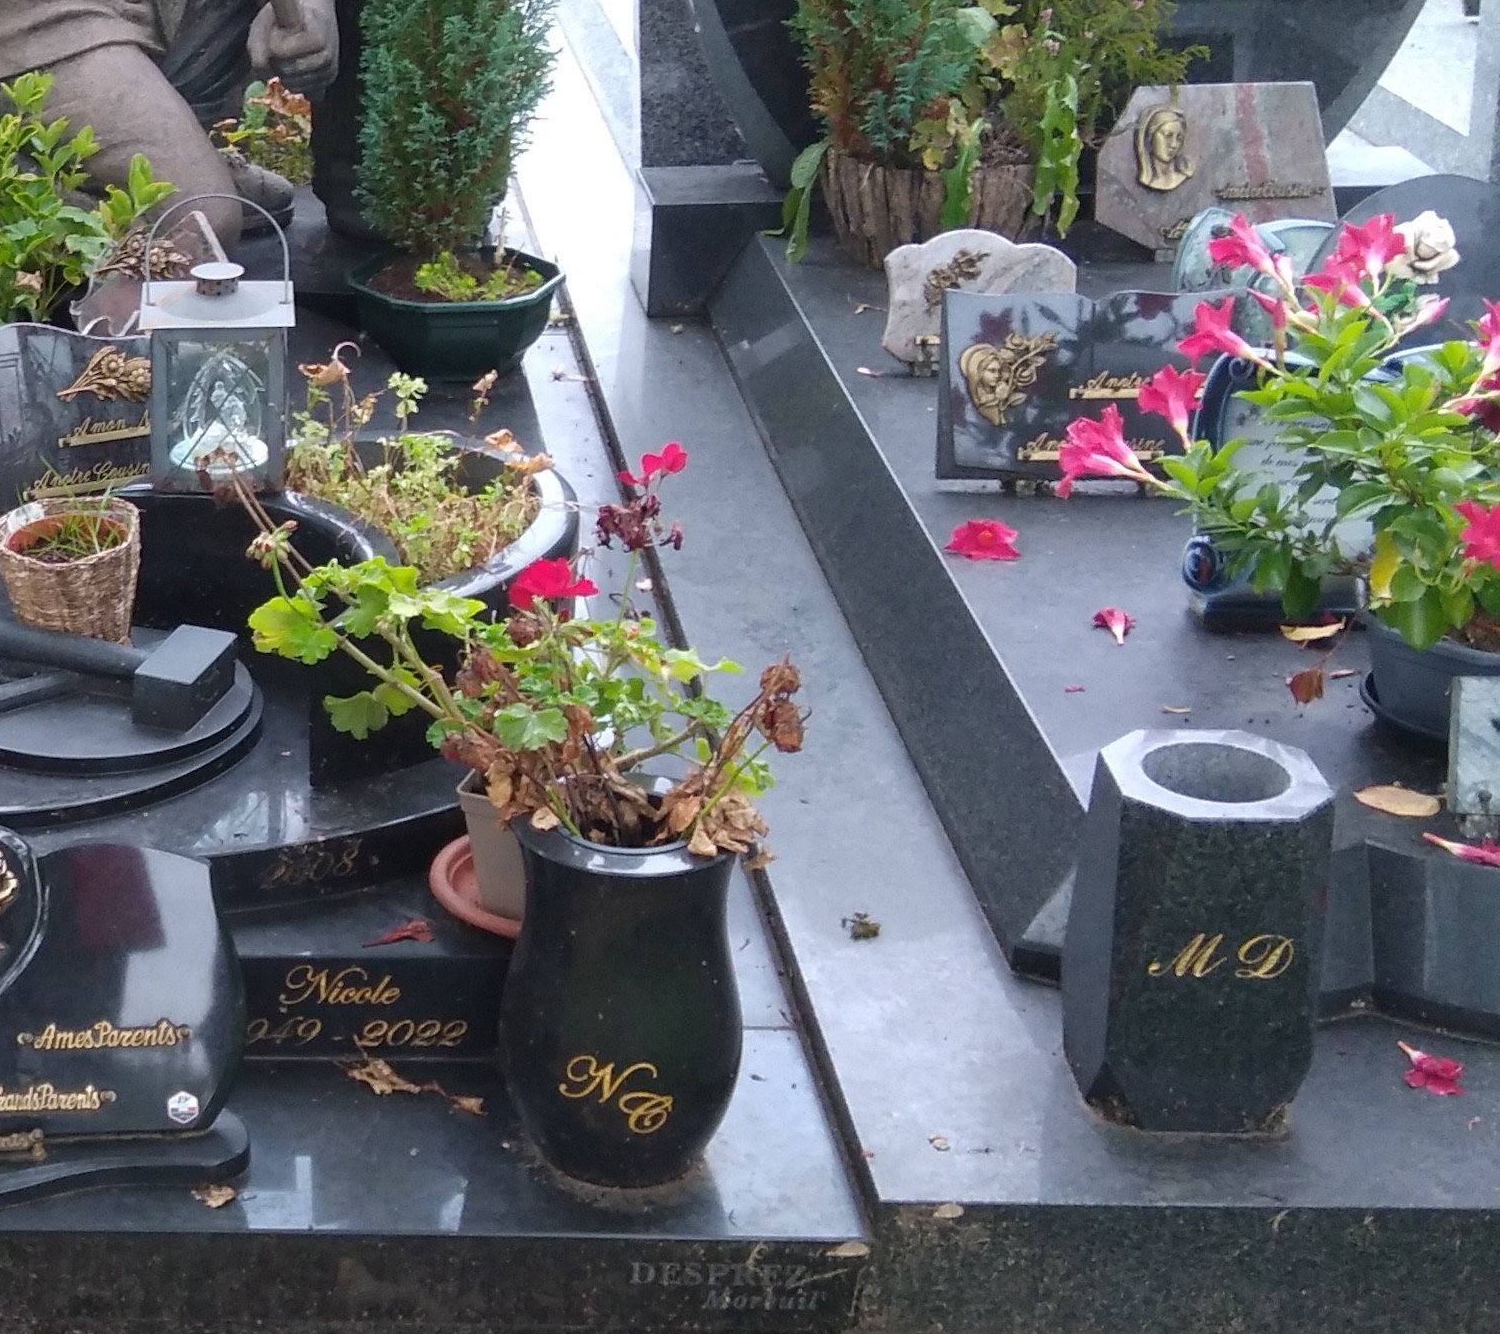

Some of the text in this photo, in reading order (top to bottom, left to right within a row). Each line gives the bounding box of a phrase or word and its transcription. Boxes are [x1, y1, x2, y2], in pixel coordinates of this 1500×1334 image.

[1148, 932, 1295, 980] M D
[278, 964, 402, 1006] Nicole
[352, 1019, 469, 1048] 2022
